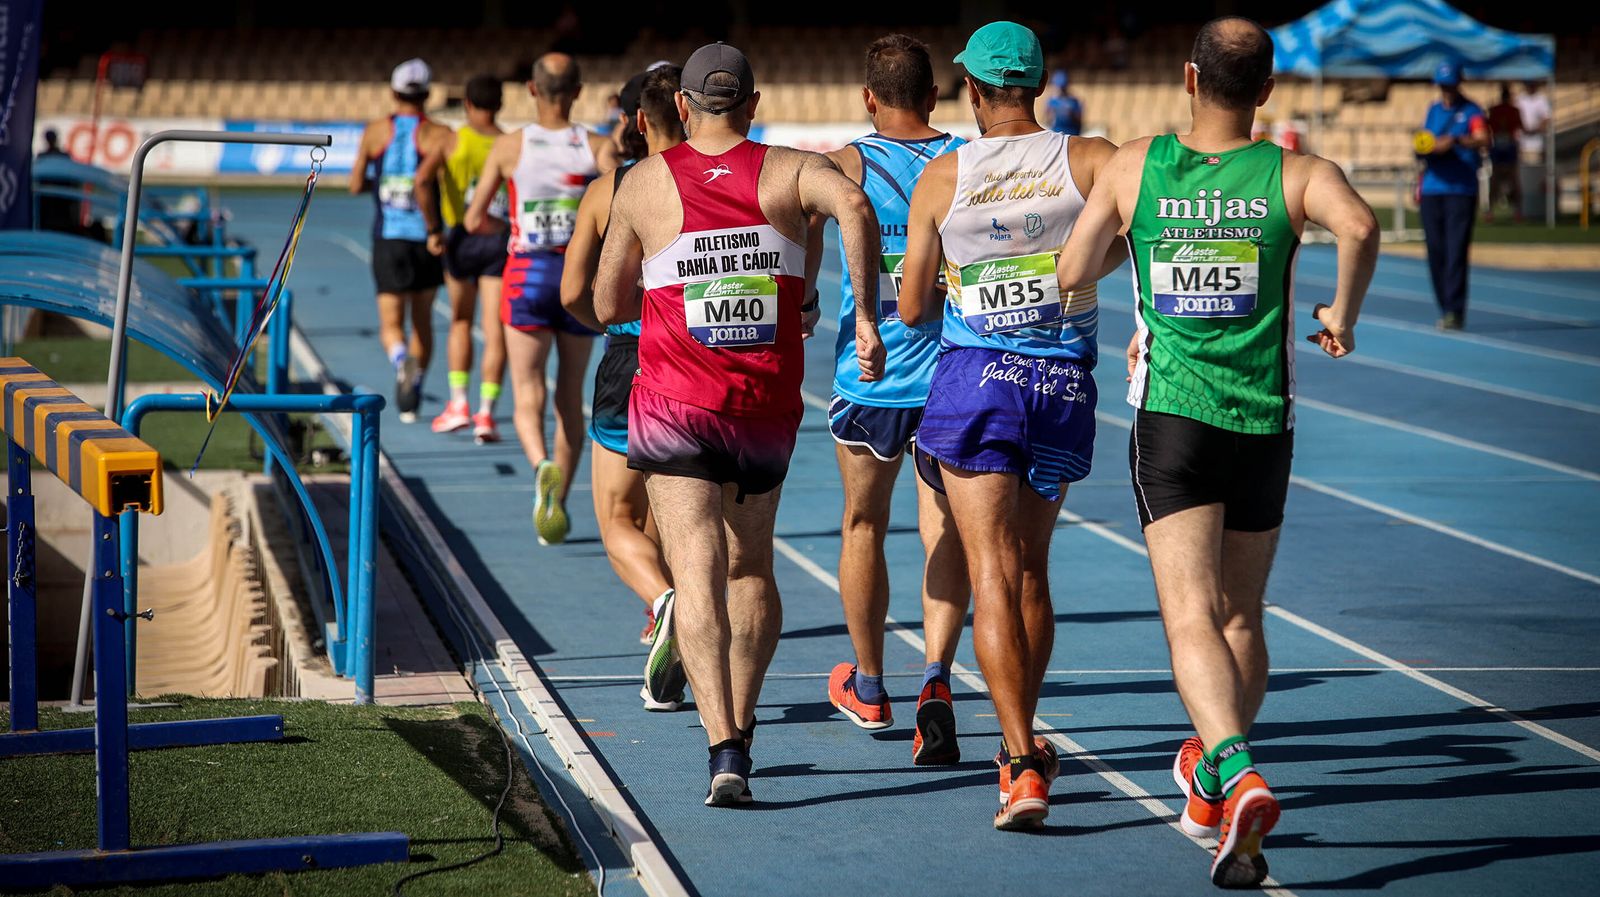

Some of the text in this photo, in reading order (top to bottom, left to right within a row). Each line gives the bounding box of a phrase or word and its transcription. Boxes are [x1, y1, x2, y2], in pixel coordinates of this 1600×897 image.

[1009, 181, 1035, 200] del
[1039, 180, 1065, 197] Sur
[1156, 189, 1269, 226] mijas
[694, 232, 760, 253] ATLETISMO
[1160, 227, 1262, 238] ATLETISMO
[677, 248, 781, 278] BAHÍA DE CÁDIZ
[1172, 266, 1241, 291] M45
[979, 279, 1044, 310] M35
[704, 298, 764, 323] M40
[1002, 352, 1033, 367] Club
[979, 361, 1028, 388] Jable
